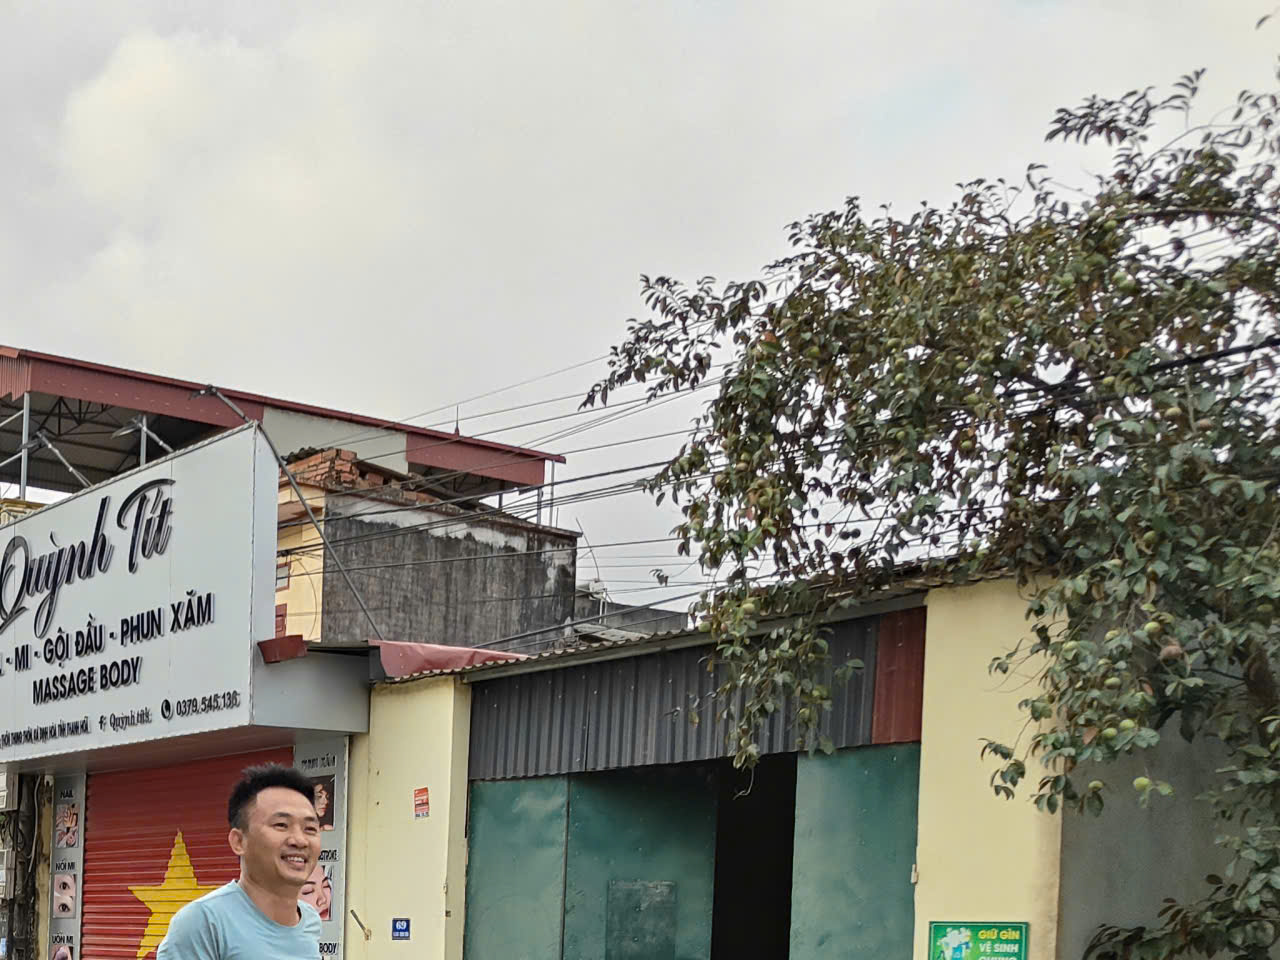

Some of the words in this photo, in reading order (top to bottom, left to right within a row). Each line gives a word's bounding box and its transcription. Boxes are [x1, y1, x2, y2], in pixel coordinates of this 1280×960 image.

[15, 644, 31, 671] MI
[44, 627, 72, 668] GỘI
[75, 612, 105, 657] ĐẦU
[121, 607, 164, 647] PHUN
[170, 589, 215, 632] XĂM
[33, 667, 96, 704] MASSAGE
[100, 656, 142, 690] BODY
[979, 941, 993, 955] VỆ
[994, 943, 1019, 953] SINH
[999, 928, 1020, 940] GÌN
